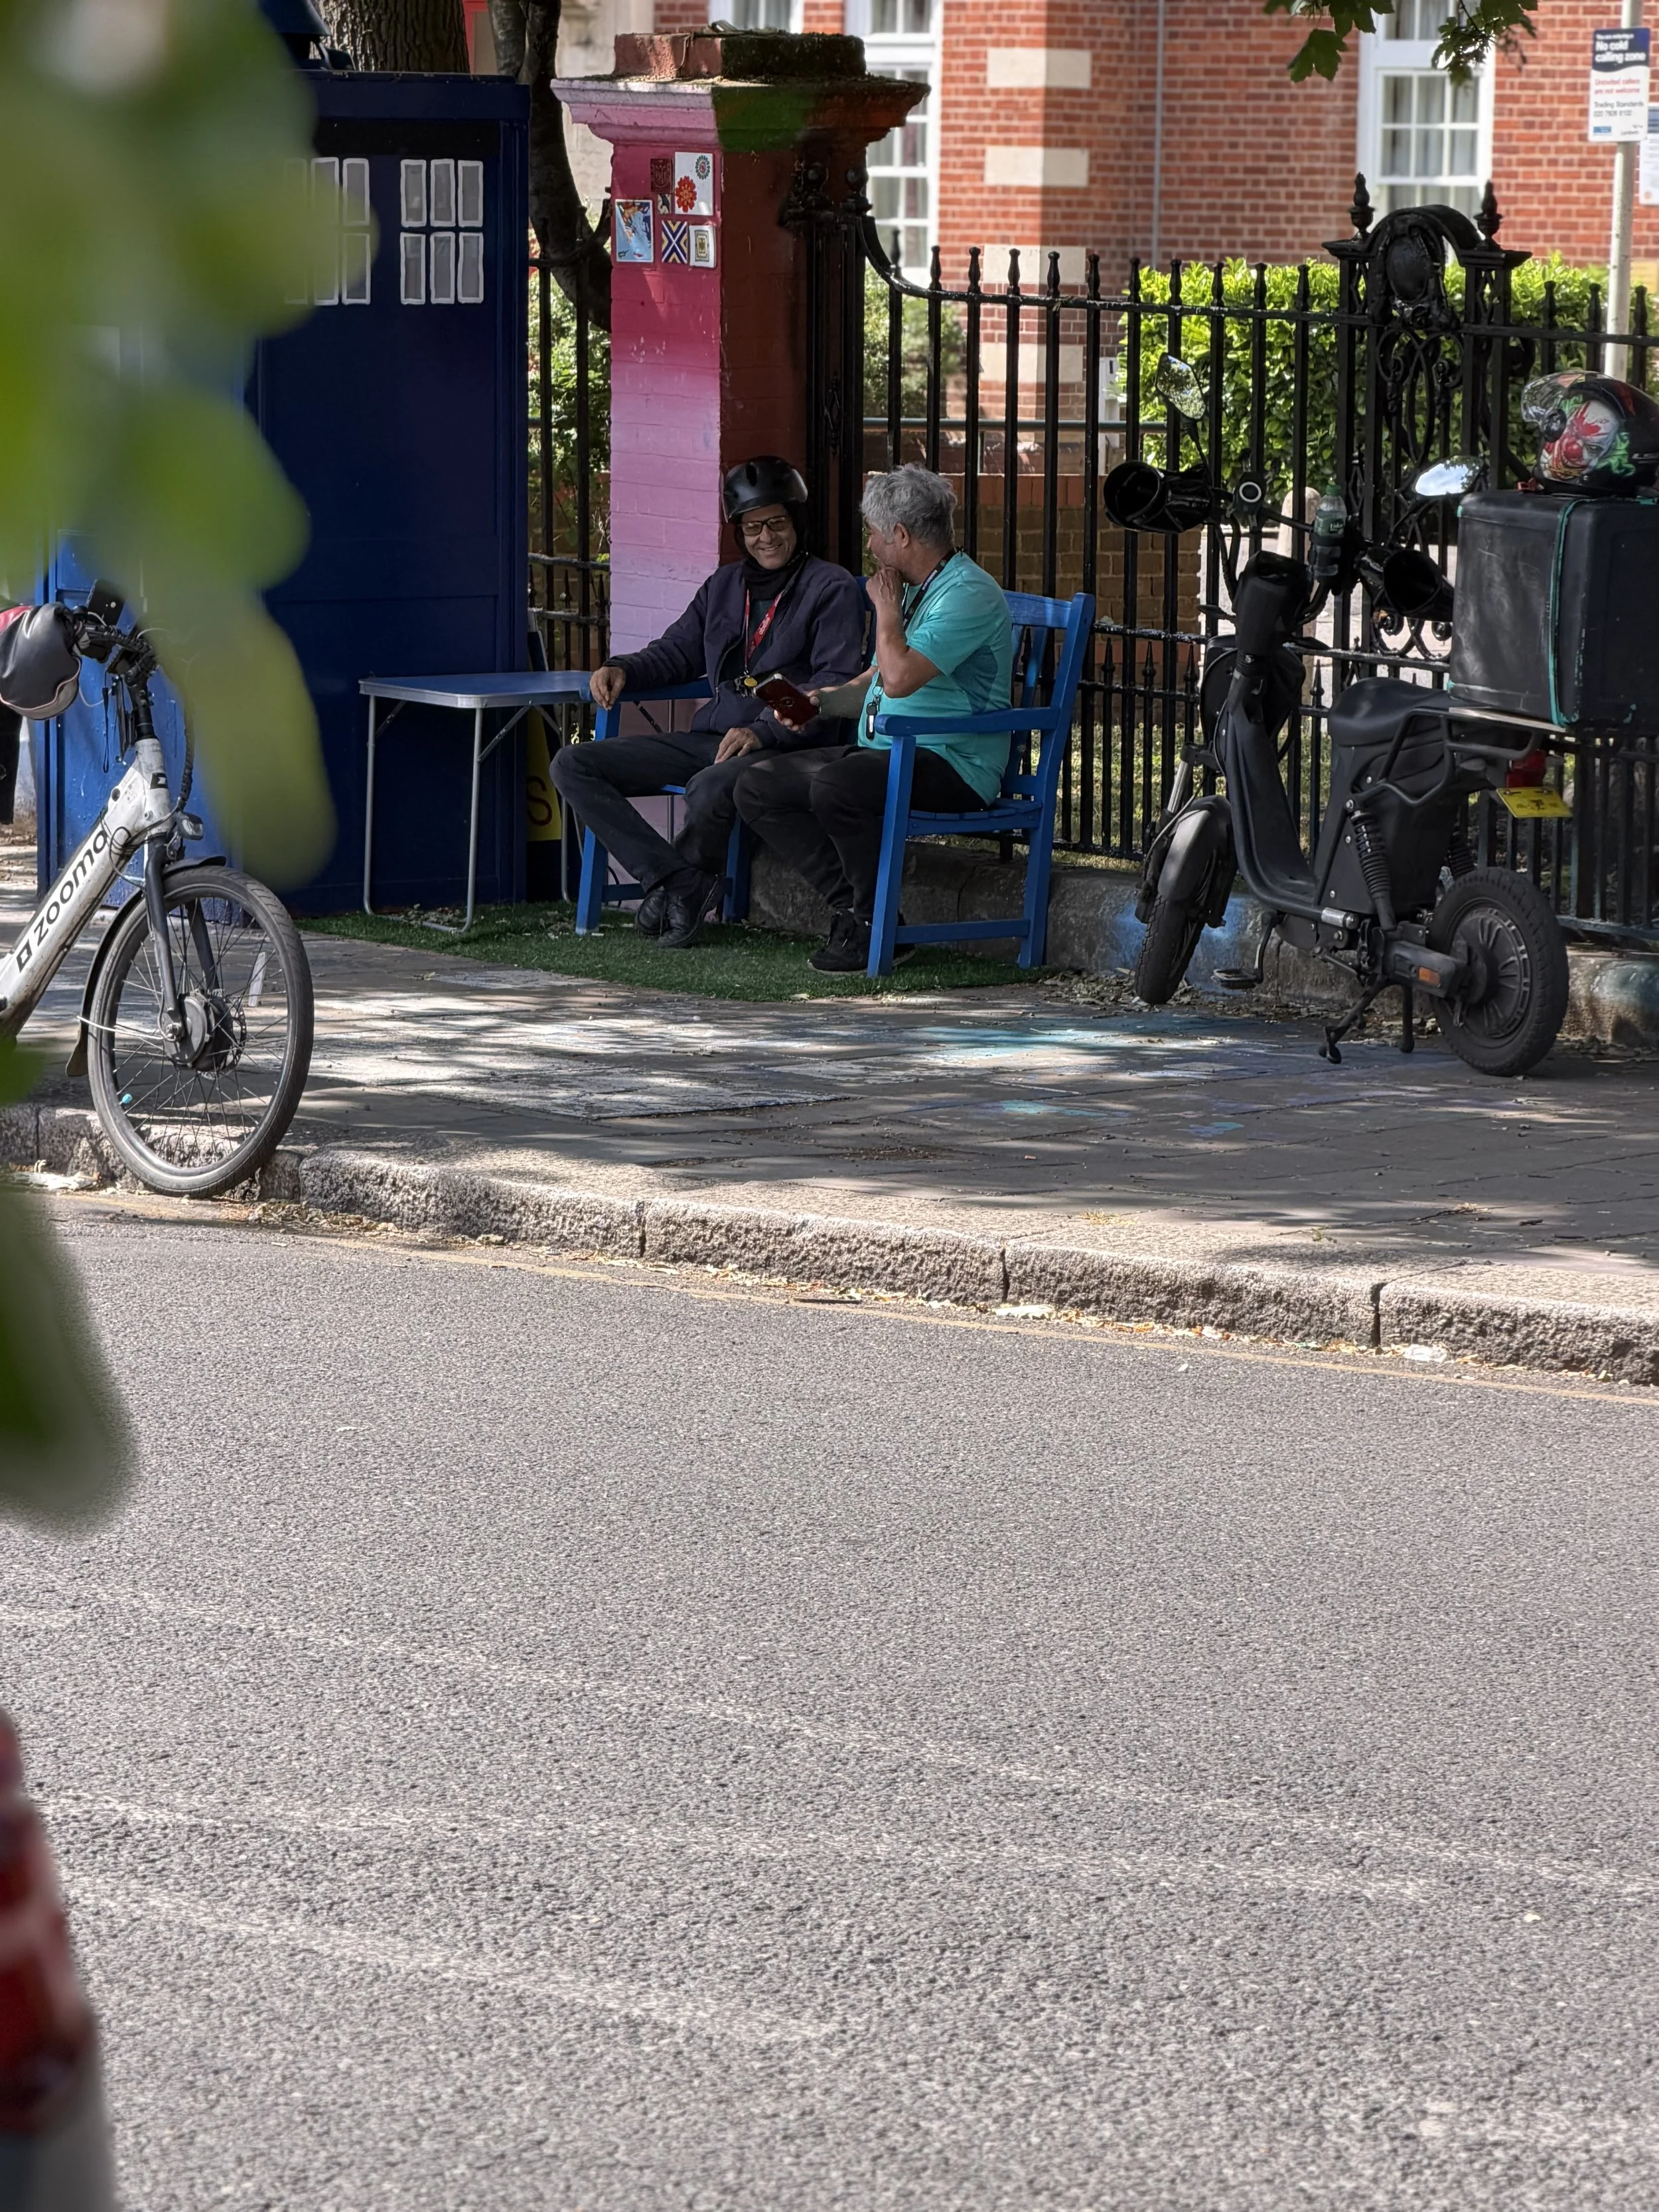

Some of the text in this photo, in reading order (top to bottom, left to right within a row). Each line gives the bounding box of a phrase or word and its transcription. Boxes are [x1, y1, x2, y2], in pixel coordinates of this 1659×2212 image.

[1595, 40, 1628, 51] No cold
[1595, 52, 1646, 64] calling zone
[34, 830, 108, 947] zoomo
